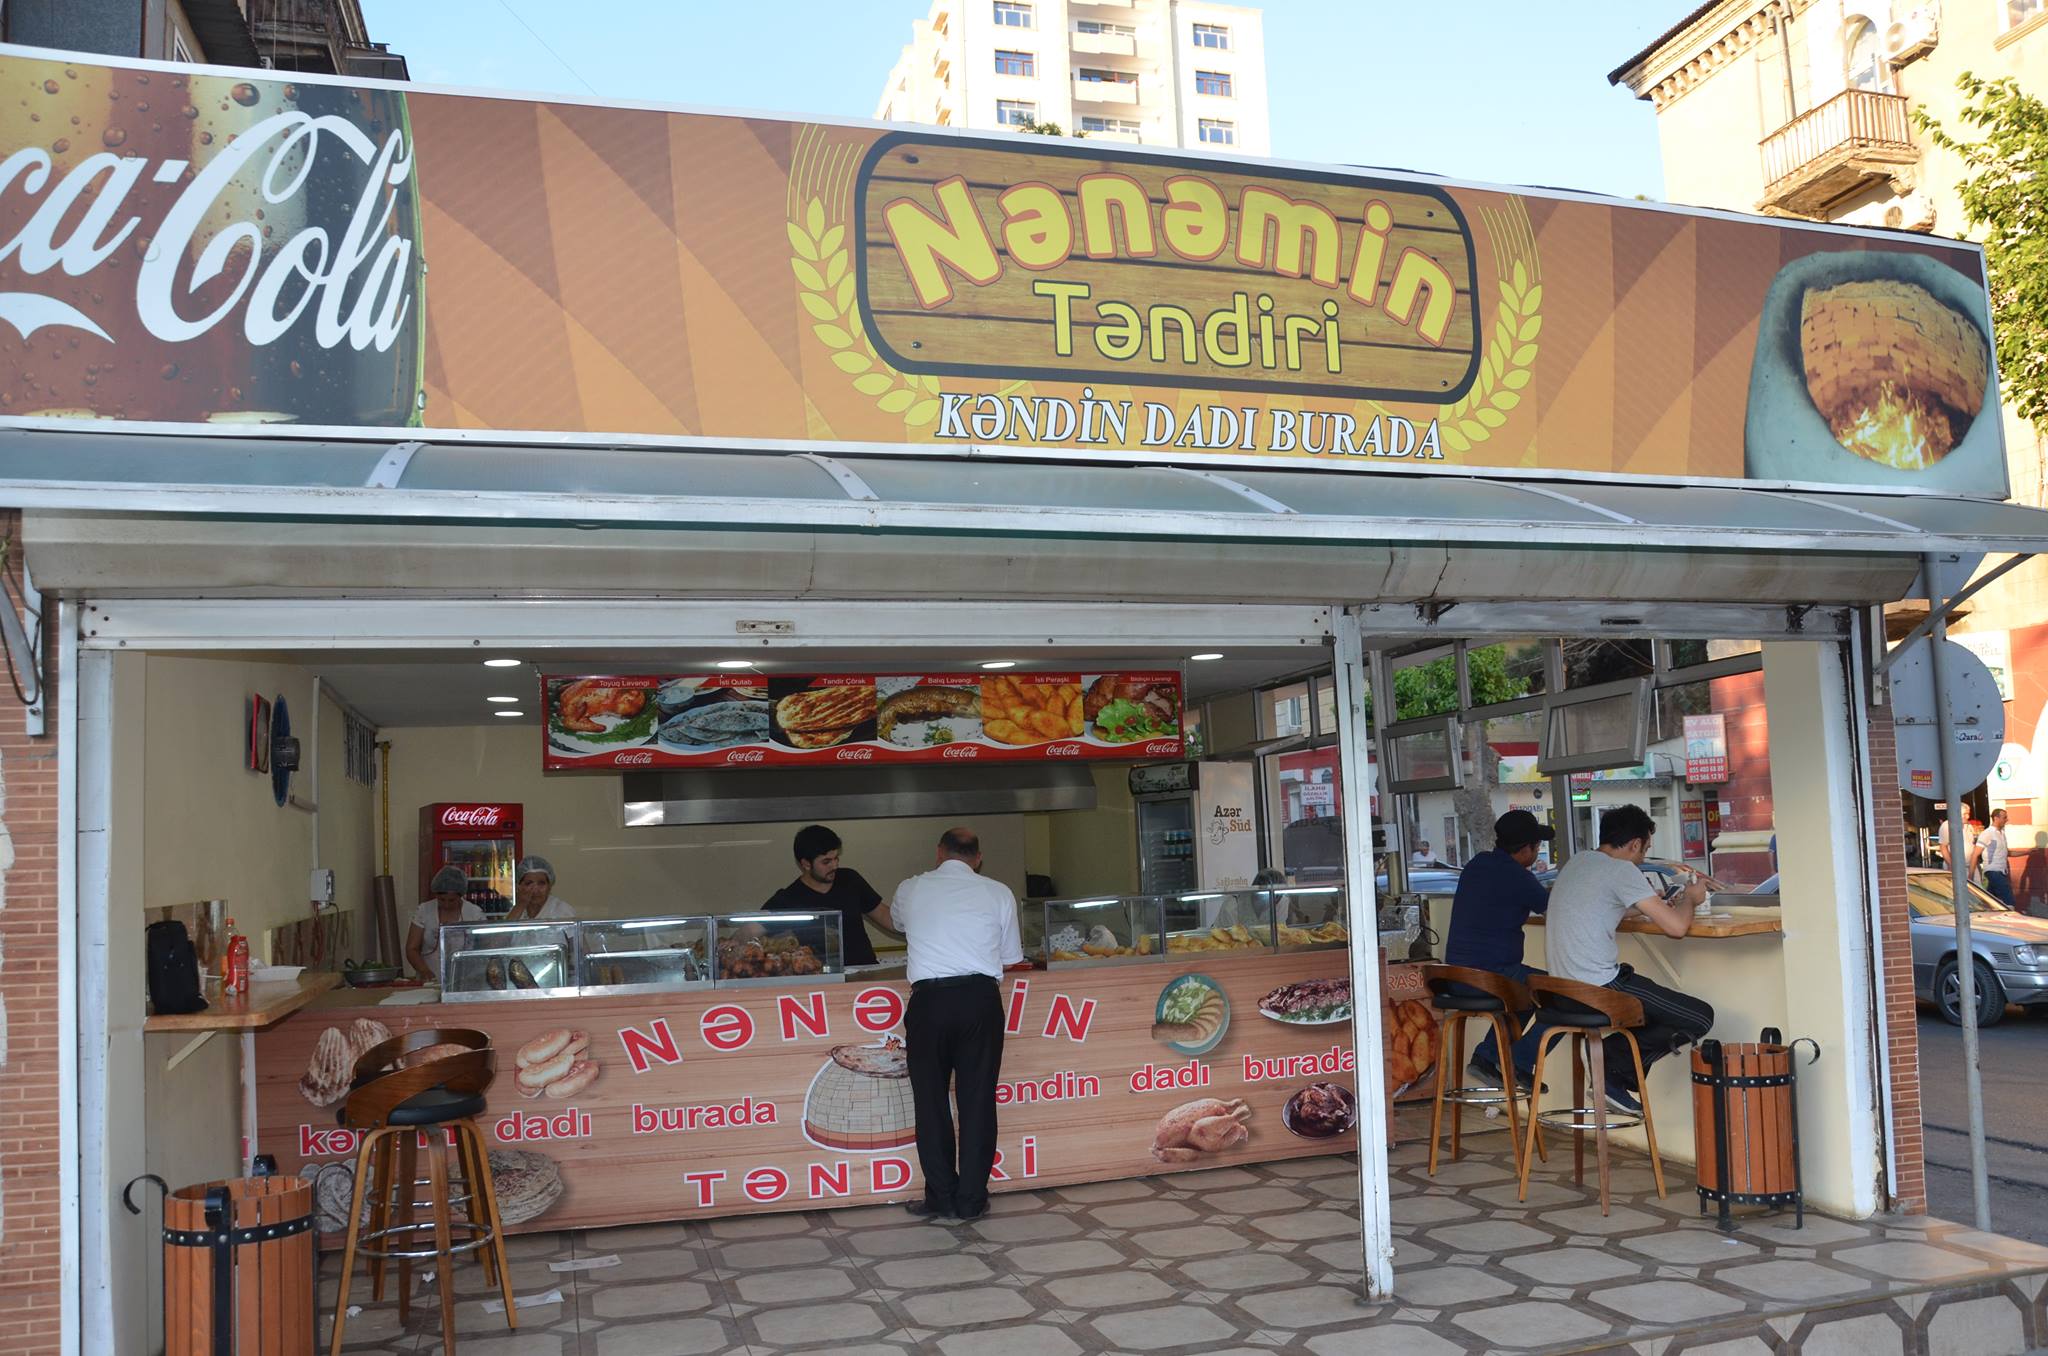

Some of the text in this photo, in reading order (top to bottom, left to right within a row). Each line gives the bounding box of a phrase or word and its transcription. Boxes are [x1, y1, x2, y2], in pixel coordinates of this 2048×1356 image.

[882, 172, 1457, 347] Nənəmin
[1033, 280, 1342, 374] Təndiri
[934, 387, 1444, 459] KƏNDİN DADI BURADA
[442, 806, 501, 826] Coca-Cola
[1214, 805, 1242, 817] Azər
[1229, 818, 1252, 832] Süd
[617, 978, 1098, 1074] NƏNƏİN
[993, 1070, 1101, 1106] əndin
[1129, 1059, 1211, 1092] dadı
[495, 1107, 592, 1143] dadı
[632, 1096, 778, 1134] burada
